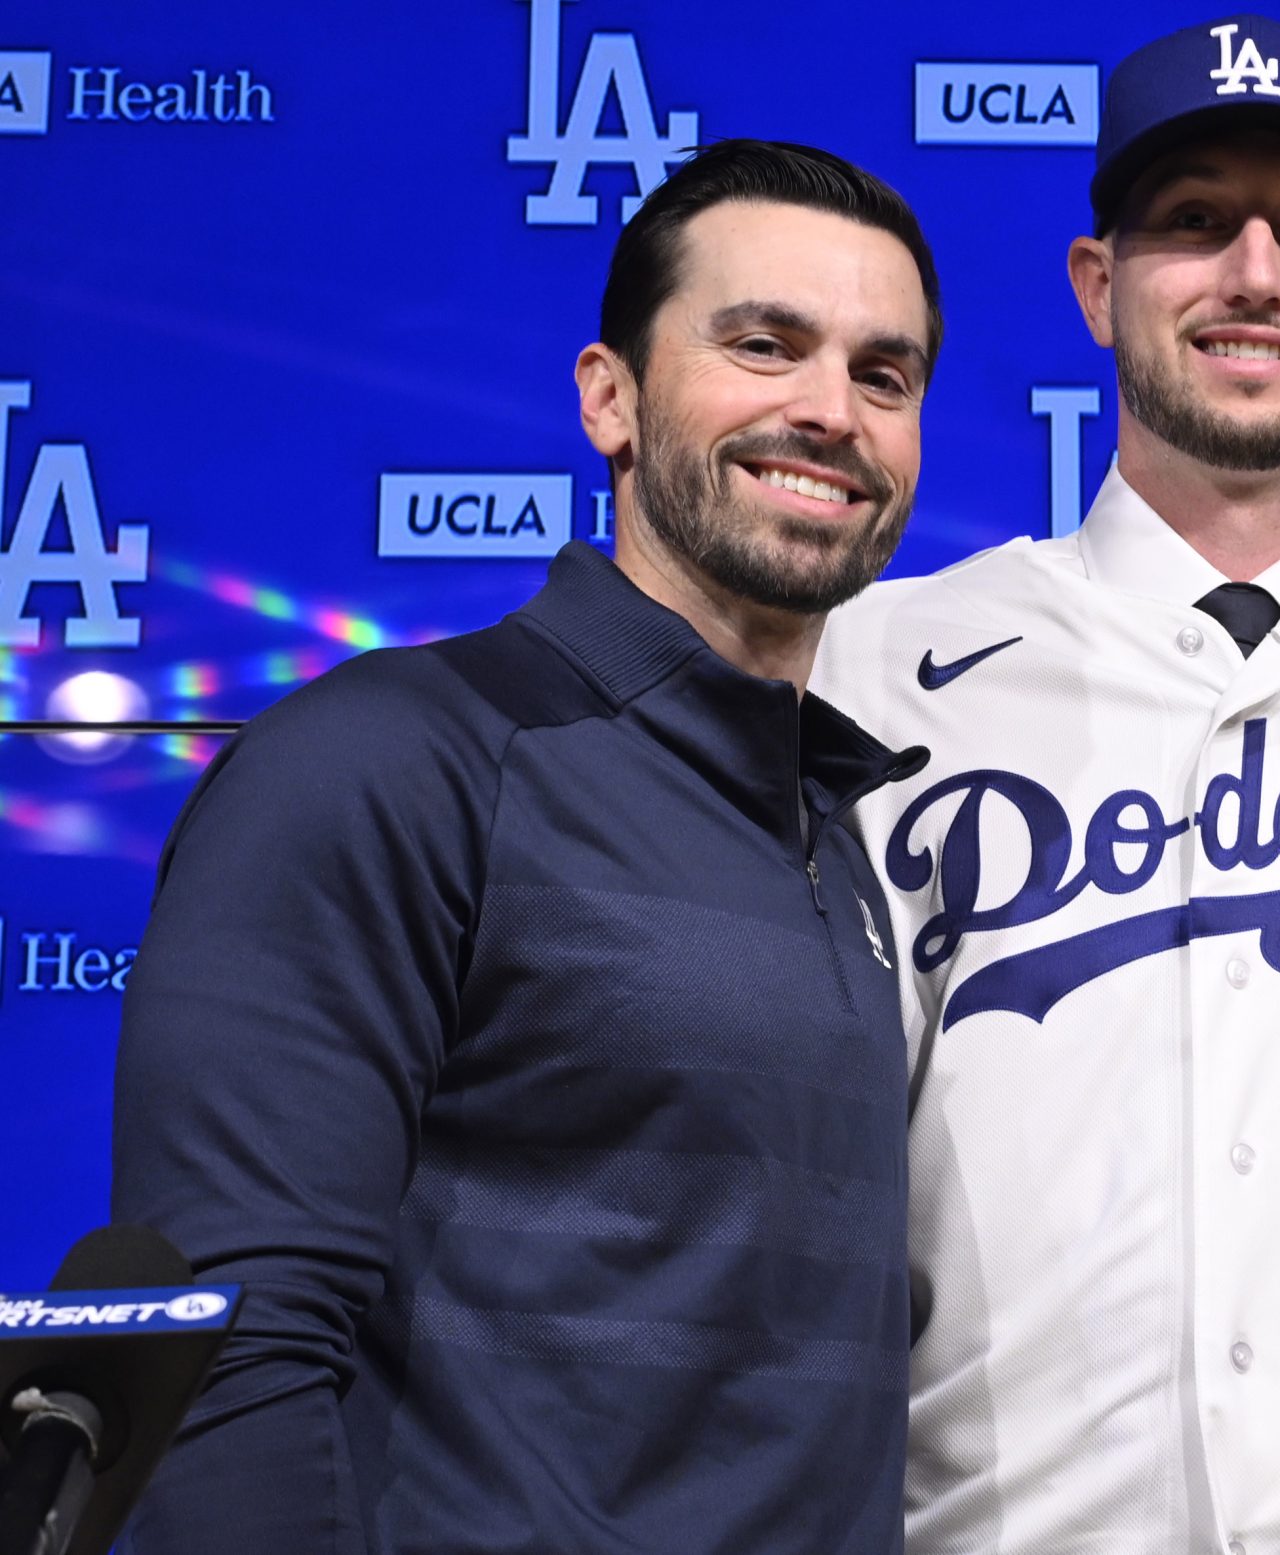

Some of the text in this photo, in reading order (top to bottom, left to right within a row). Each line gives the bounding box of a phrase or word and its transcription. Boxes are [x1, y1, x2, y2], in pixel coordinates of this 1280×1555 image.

[67, 67, 274, 121] Health
[942, 84, 1075, 124] UCLA
[407, 495, 545, 535] UCLA
[19, 932, 138, 991] Hea
